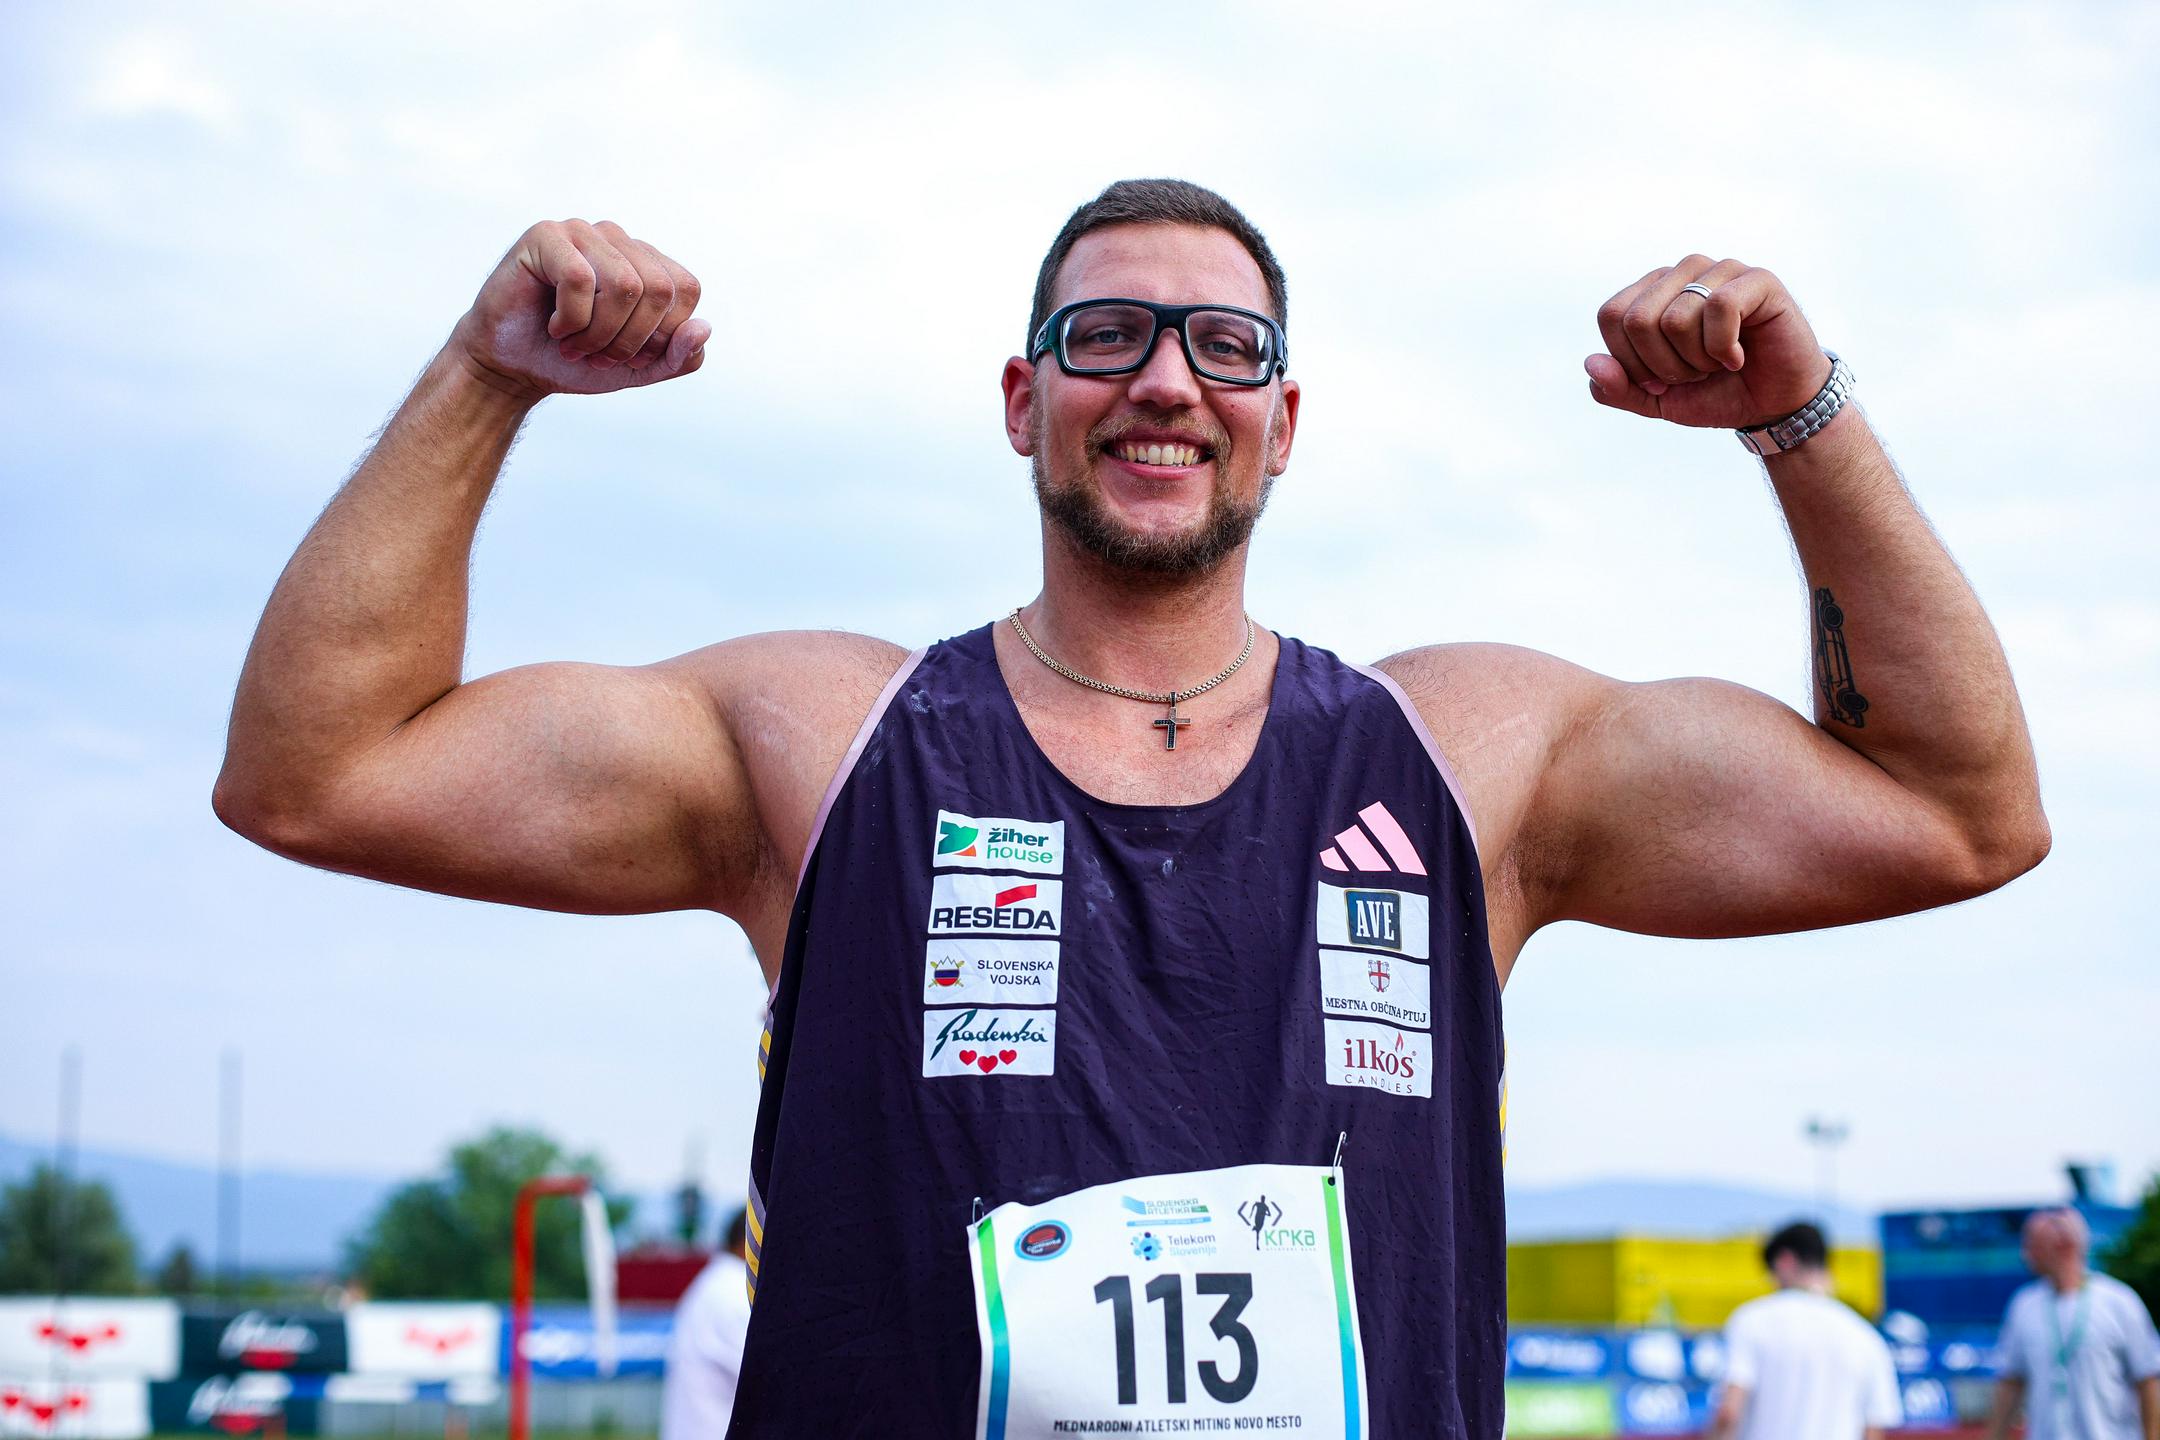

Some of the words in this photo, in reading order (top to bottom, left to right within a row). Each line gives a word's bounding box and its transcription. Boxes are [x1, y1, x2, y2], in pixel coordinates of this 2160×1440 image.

[987, 827, 1049, 848] žiher
[986, 844, 1053, 864] house
[932, 906, 1056, 931] RESEDA
[1355, 900, 1395, 941] AVE
[977, 959, 1055, 972] SLOVENSKA
[989, 974, 1041, 986] VOJSKA
[1325, 997, 1368, 1012] MESTNA
[1370, 1000, 1402, 1018] OBČINA
[1402, 1009, 1426, 1023] PTUJ
[1344, 1074, 1413, 1095] CANDLES
[1146, 1198, 1199, 1208] SLOVENSKA
[1147, 1206, 1190, 1216] ATLETIKA
[1167, 1234, 1216, 1246] Telekom
[1169, 1245, 1217, 1257] Slovenije
[1093, 1272, 1259, 1406] 113
[1053, 1419, 1133, 1433] MEDNARODNI
[1135, 1419, 1190, 1433] ATLETSKI
[1193, 1418, 1231, 1431] MITING
[1234, 1416, 1264, 1430] NOVO
[1266, 1415, 1302, 1429] MESTO
